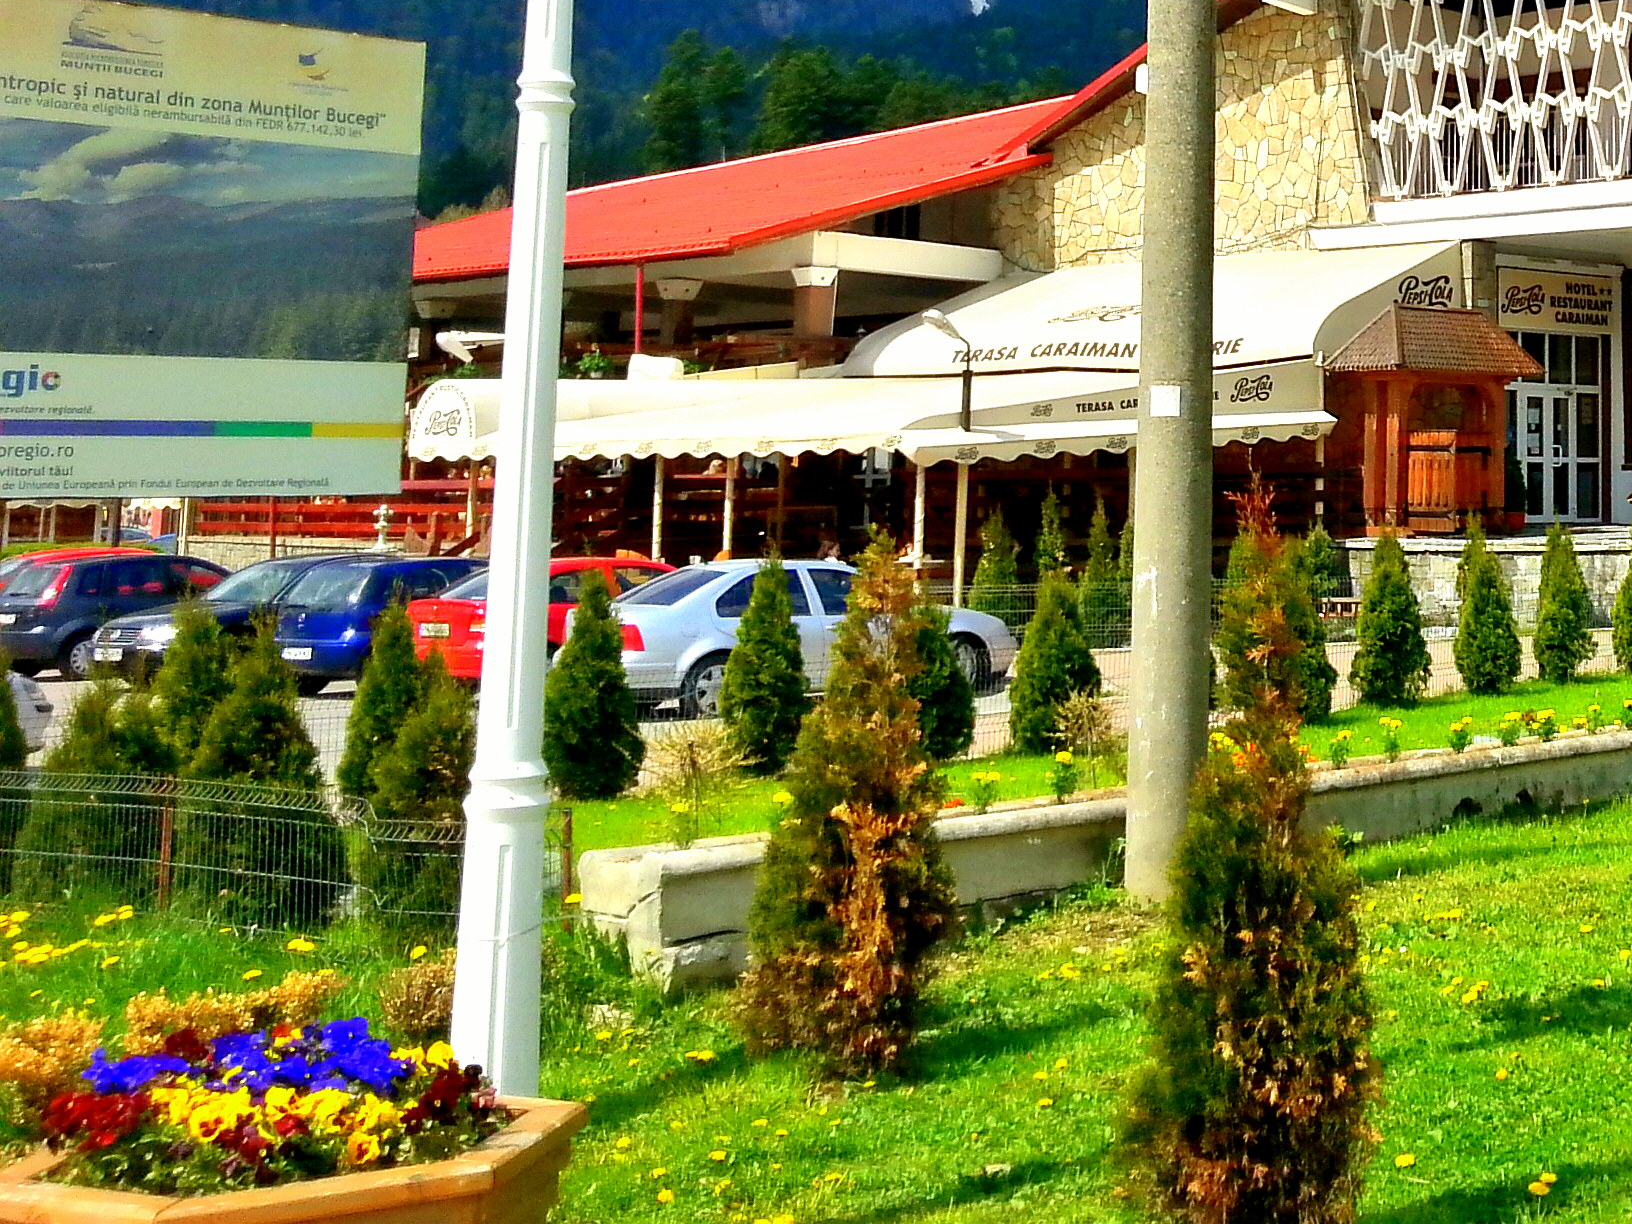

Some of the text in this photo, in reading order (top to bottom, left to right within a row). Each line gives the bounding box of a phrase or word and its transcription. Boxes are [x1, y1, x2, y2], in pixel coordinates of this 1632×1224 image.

[114, 66, 163, 78] BUCEGI
[95, 86, 161, 105] natural
[167, 90, 195, 108] din
[201, 97, 242, 113] zona
[4, 95, 32, 106] care
[36, 98, 88, 112] valoarea
[235, 116, 252, 128] din
[256, 117, 284, 130] FEDR
[1565, 282, 1598, 296] HOTEL
[1549, 295, 1613, 312] RESTAURANT
[1554, 311, 1608, 326] CARAIMAN
[951, 346, 1019, 364] TERASA
[1030, 342, 1138, 359] CARAIMAN
[1075, 401, 1115, 413] TERASA
[2, 480, 15, 490] de
[221, 479, 234, 488] de
